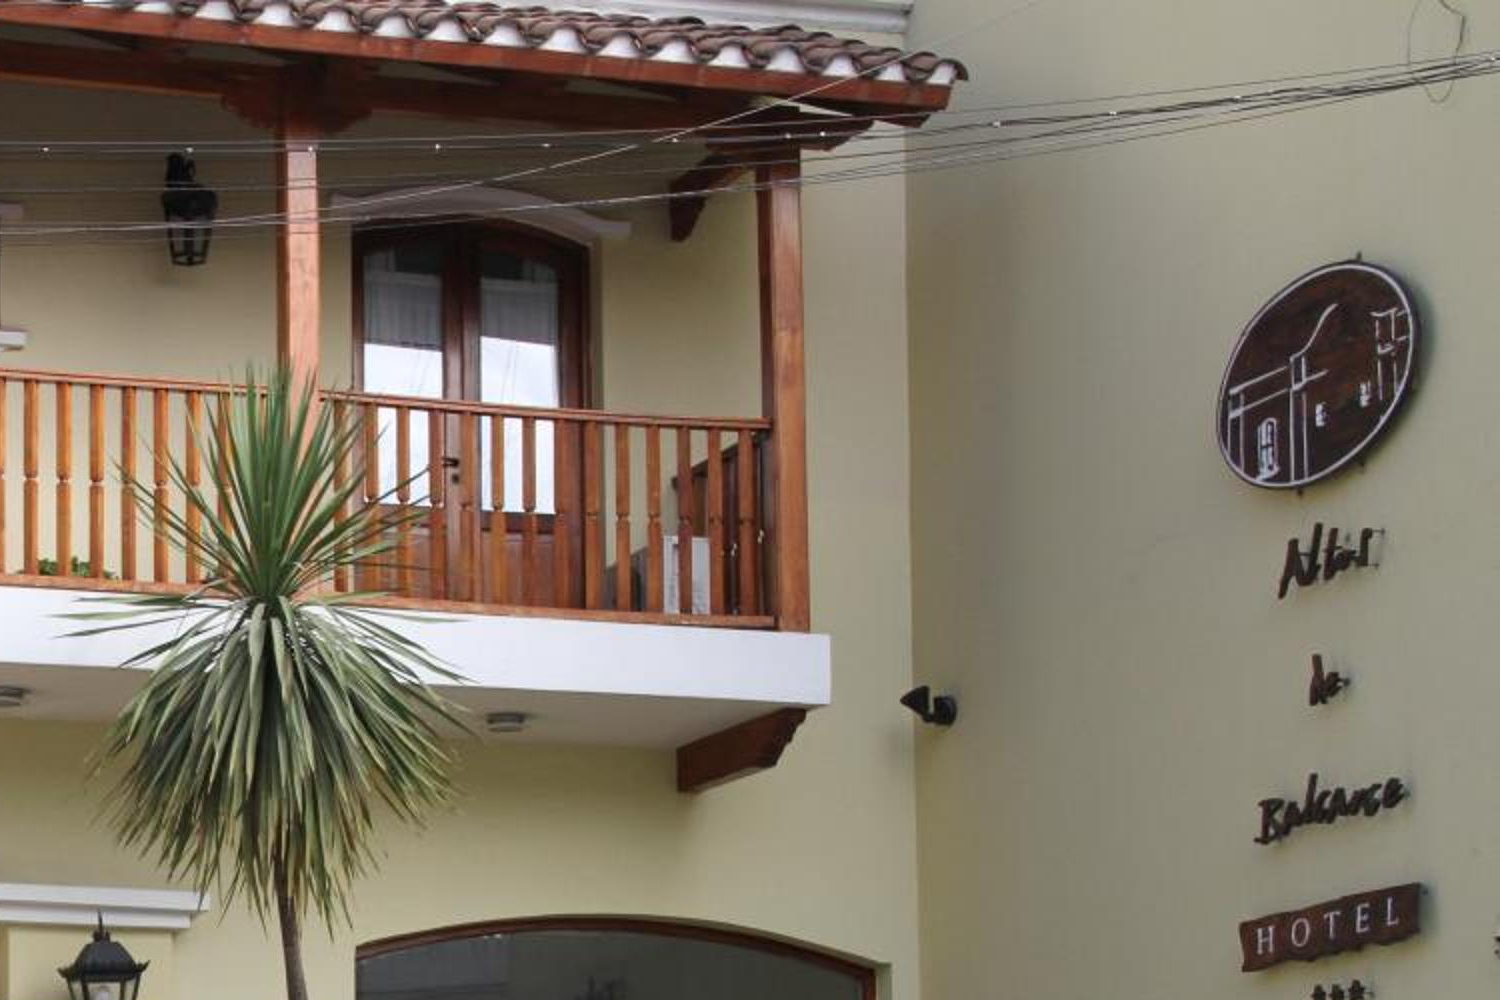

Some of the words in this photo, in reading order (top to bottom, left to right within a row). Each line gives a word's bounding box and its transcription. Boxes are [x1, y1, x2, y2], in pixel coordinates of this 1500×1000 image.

[1309, 653, 1343, 706] de
[1253, 772, 1406, 845] Balcarce
[1256, 896, 1401, 955] HOTEL
